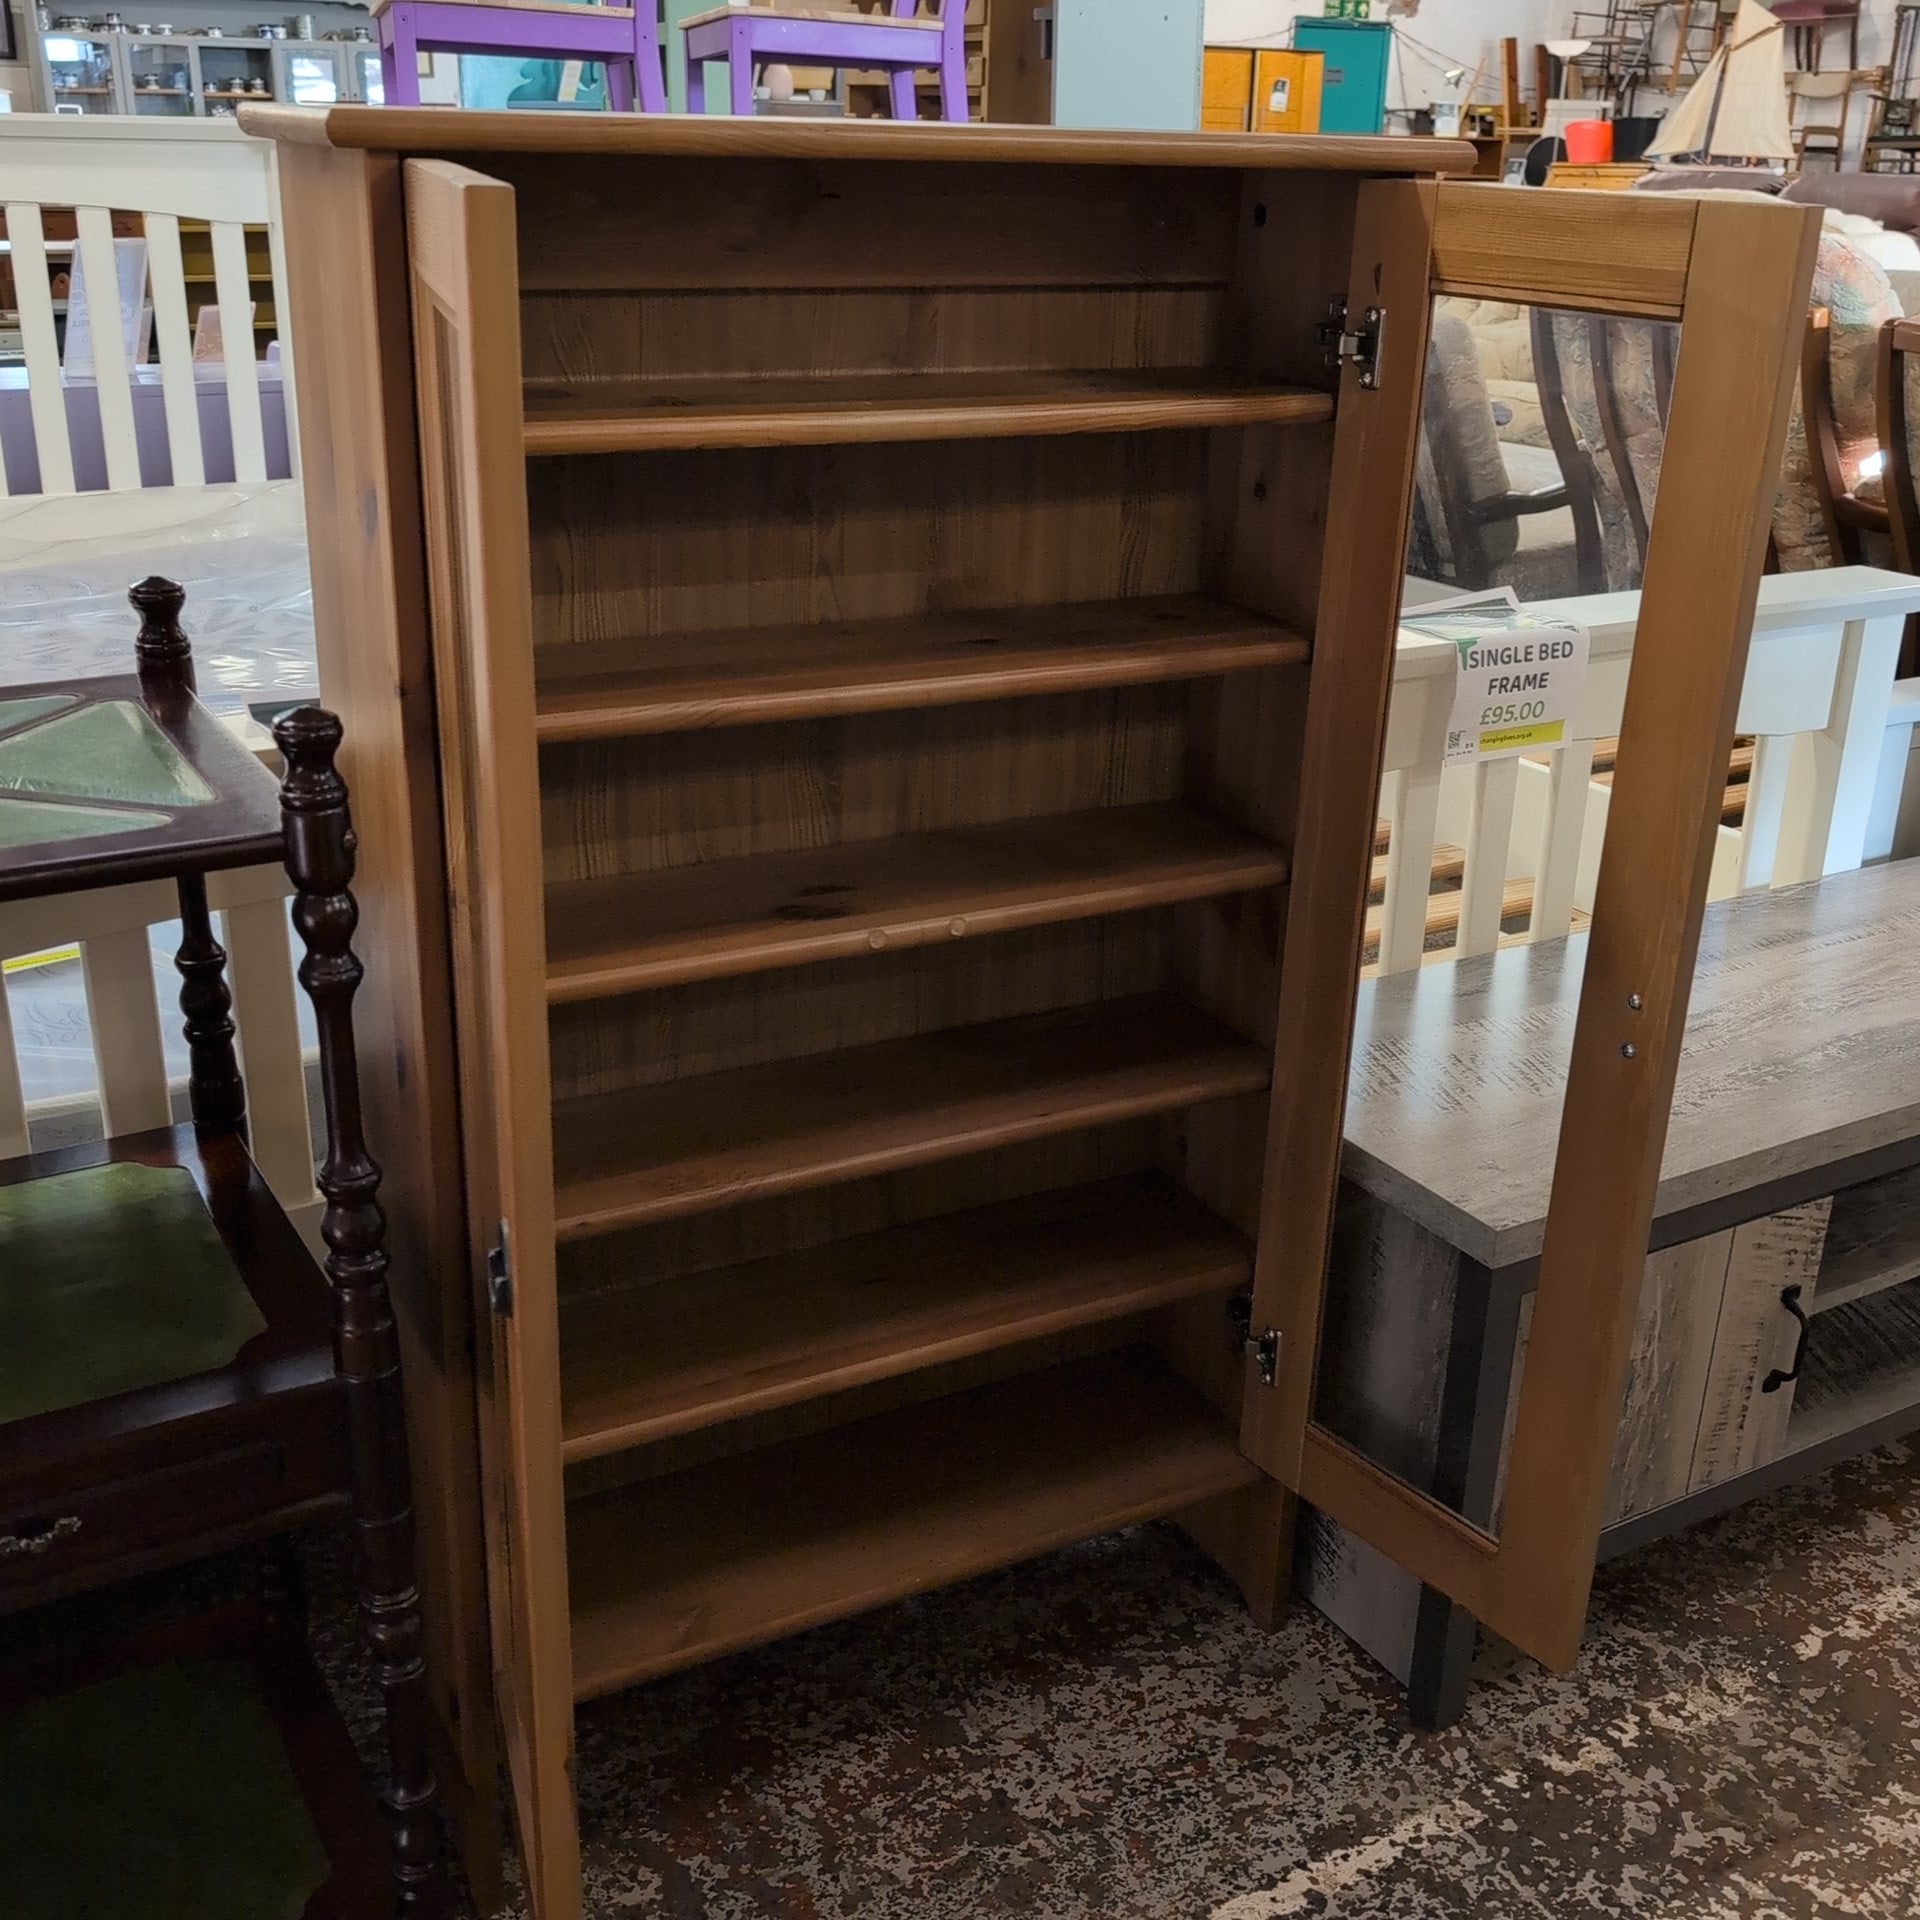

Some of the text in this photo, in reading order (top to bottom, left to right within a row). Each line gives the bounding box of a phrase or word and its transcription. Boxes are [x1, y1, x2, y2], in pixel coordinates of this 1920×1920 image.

[1469, 641, 1573, 669] SINGLE BED
[1488, 672, 1550, 695] FRAME
[1479, 700, 1545, 725] £95.00
